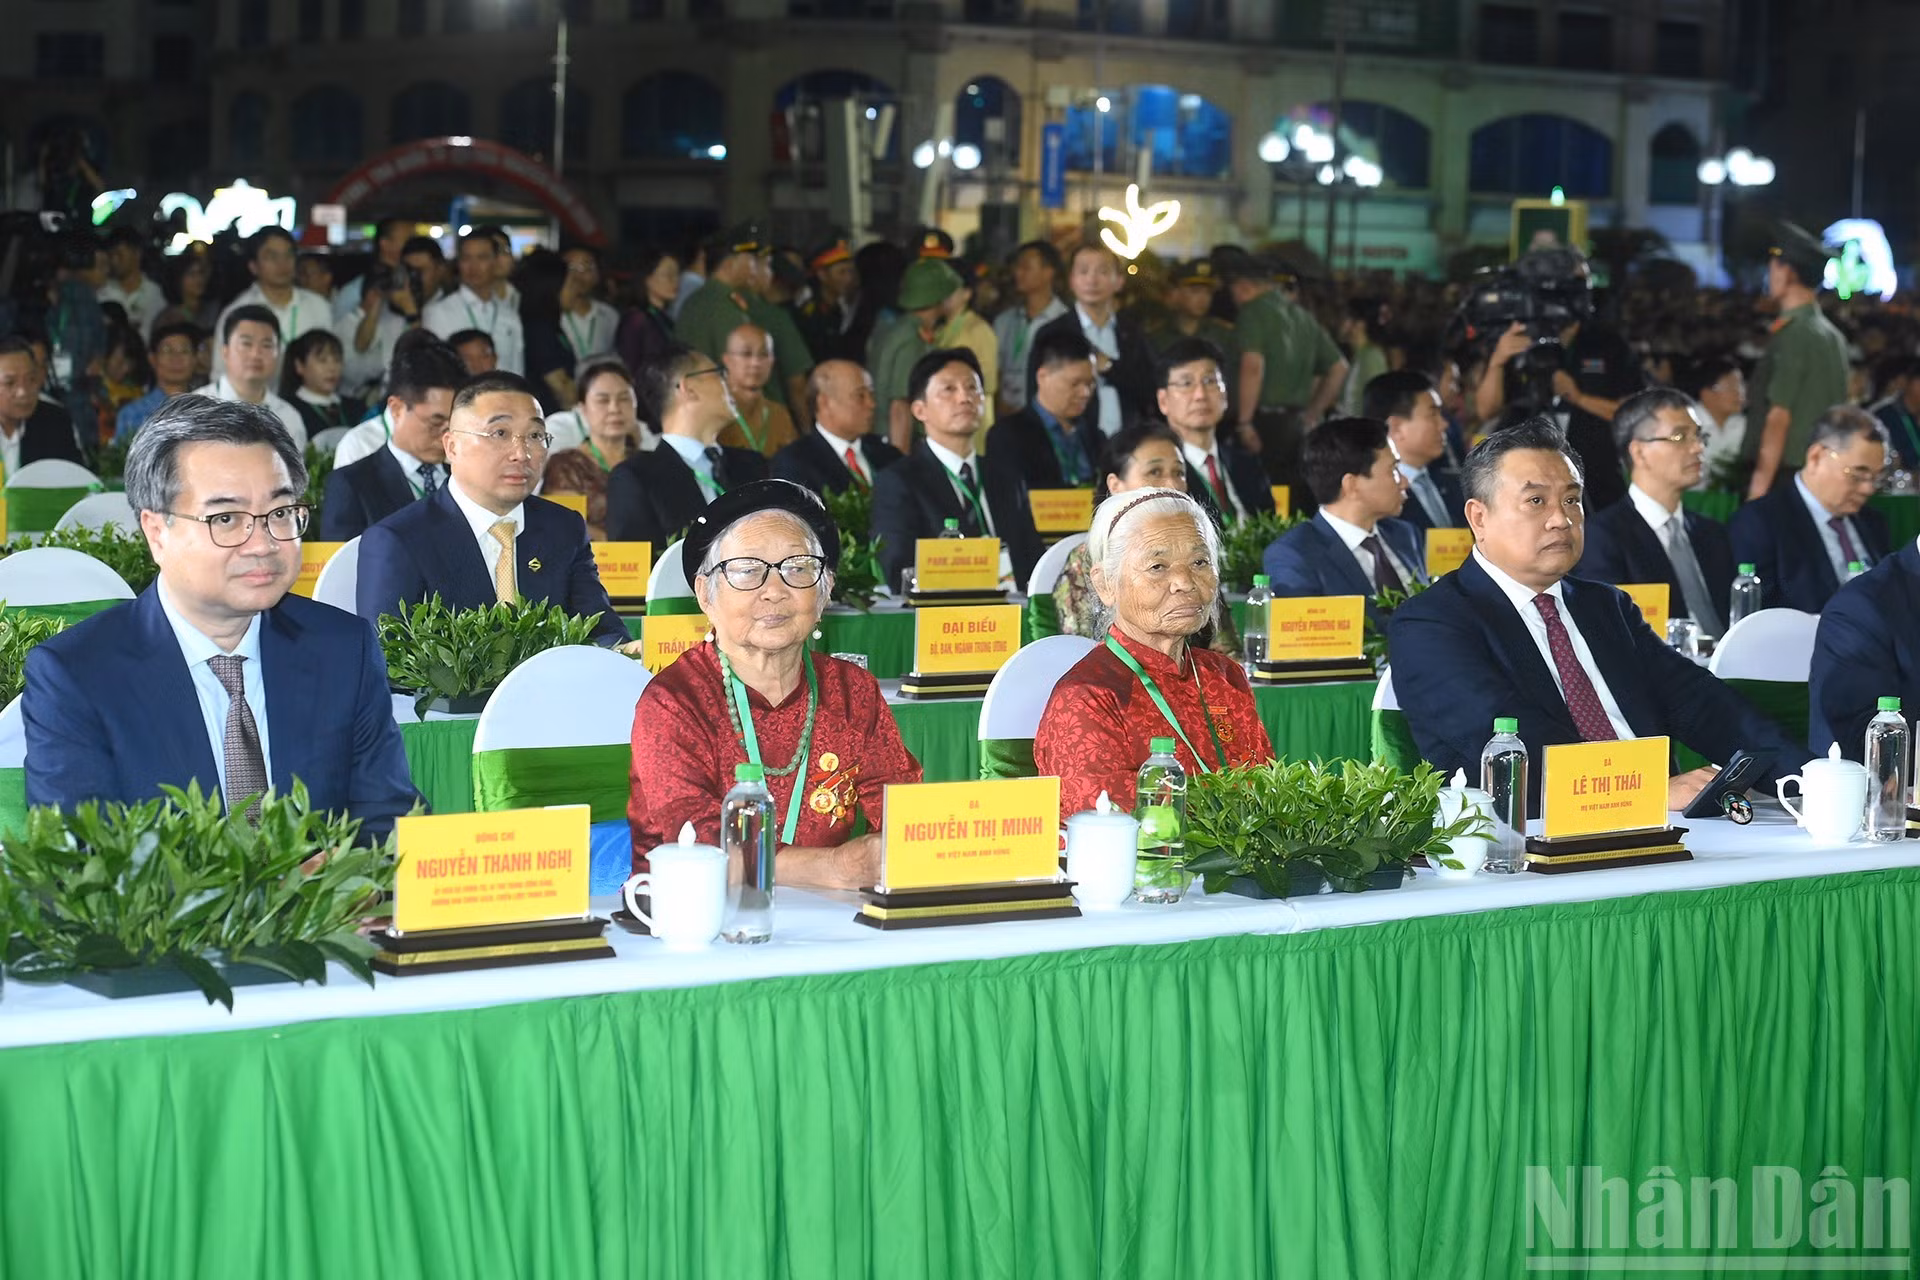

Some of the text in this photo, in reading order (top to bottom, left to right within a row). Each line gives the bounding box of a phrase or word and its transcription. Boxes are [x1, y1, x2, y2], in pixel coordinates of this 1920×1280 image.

[942, 621, 964, 637] ĐẠI
[1573, 770, 1642, 796] LÊ THỊ THÁI
[904, 814, 1044, 842] NGUYỄN THỊ MINH
[416, 849, 573, 880] NGUYỄN THANH NGHỊ
